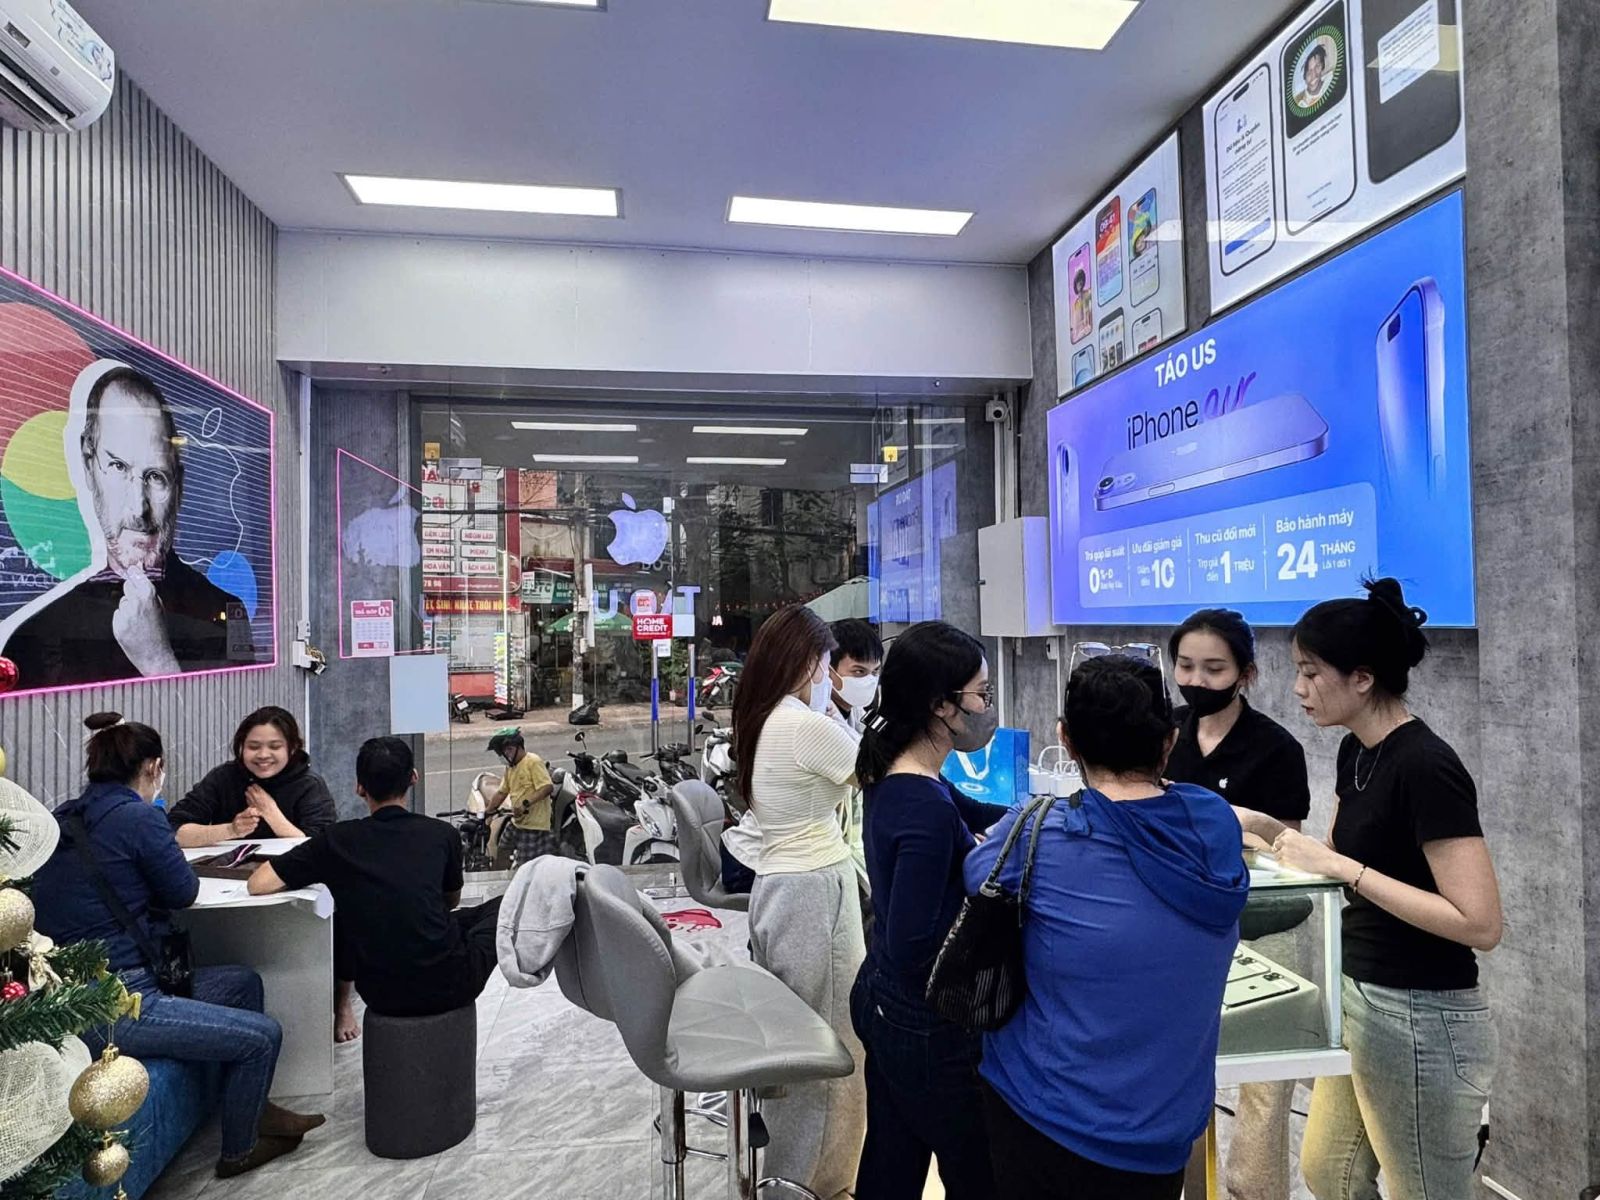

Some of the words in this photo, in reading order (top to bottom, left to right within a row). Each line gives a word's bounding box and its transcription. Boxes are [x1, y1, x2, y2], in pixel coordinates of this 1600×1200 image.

[1155, 352, 1188, 387] TÁO
[1192, 338, 1216, 371] US
[1127, 400, 1199, 450] iPhone
[1276, 517, 1297, 533] Bảo
[1298, 513, 1326, 531] hành
[1328, 509, 1354, 527] máy
[1195, 532, 1211, 545] Thu
[1220, 551, 1231, 584] 1
[1277, 540, 1319, 580] 24
[1320, 540, 1356, 556] THÁNG
[637, 617, 665, 625] HOME
